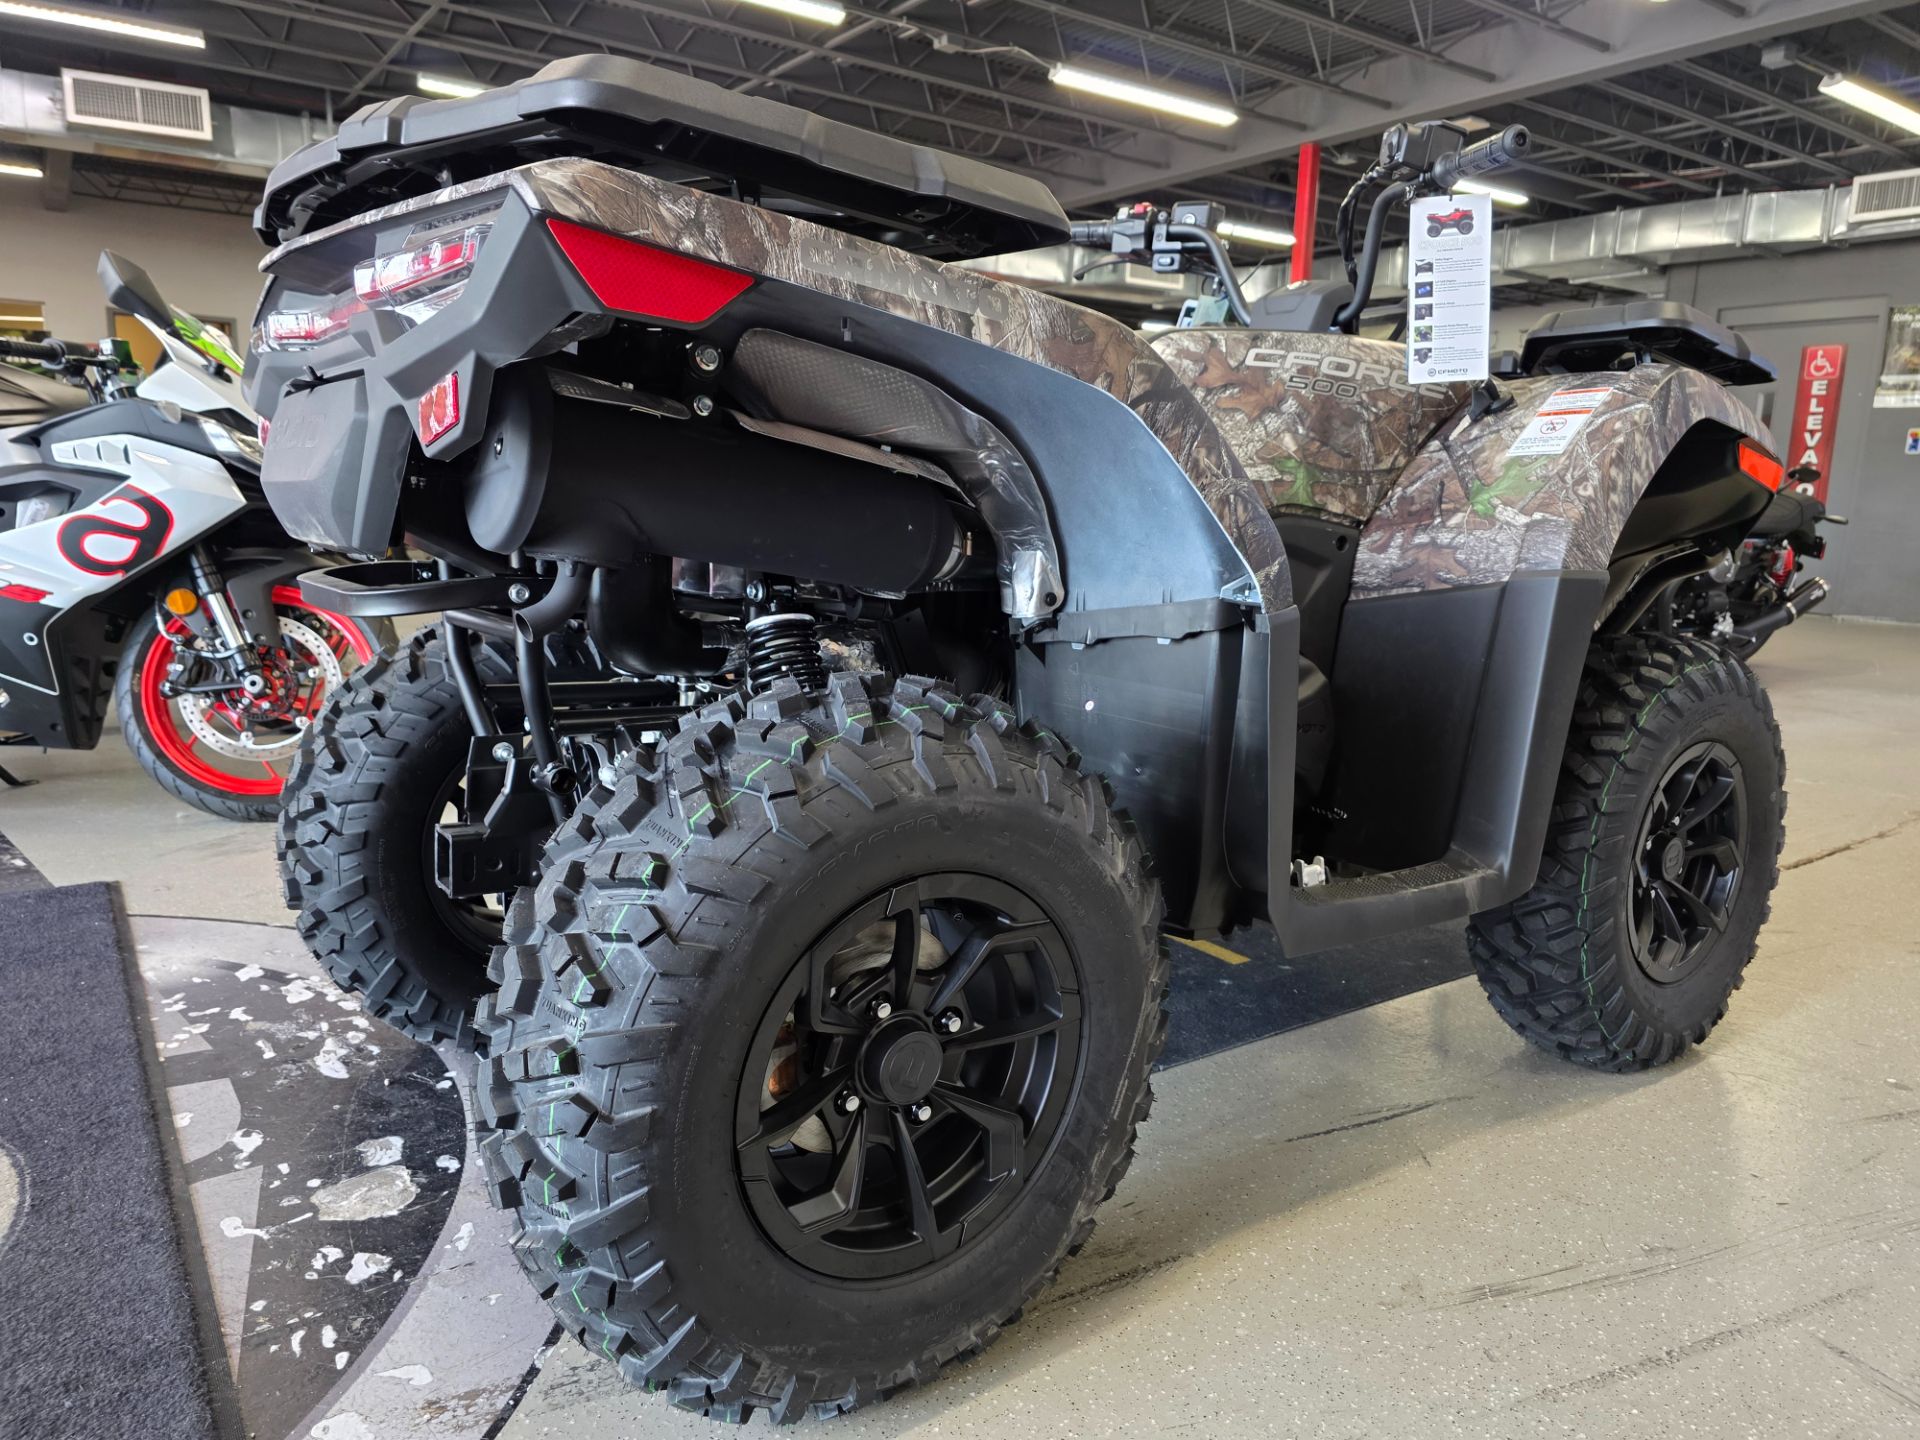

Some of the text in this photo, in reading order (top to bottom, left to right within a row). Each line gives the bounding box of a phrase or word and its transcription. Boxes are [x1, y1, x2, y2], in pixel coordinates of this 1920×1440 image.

[1245, 348, 1448, 399] CFORCE
[1285, 375, 1358, 399] 500
[1437, 367, 1469, 375] CFMOTO
[1795, 380, 1828, 497] ELEVAO
